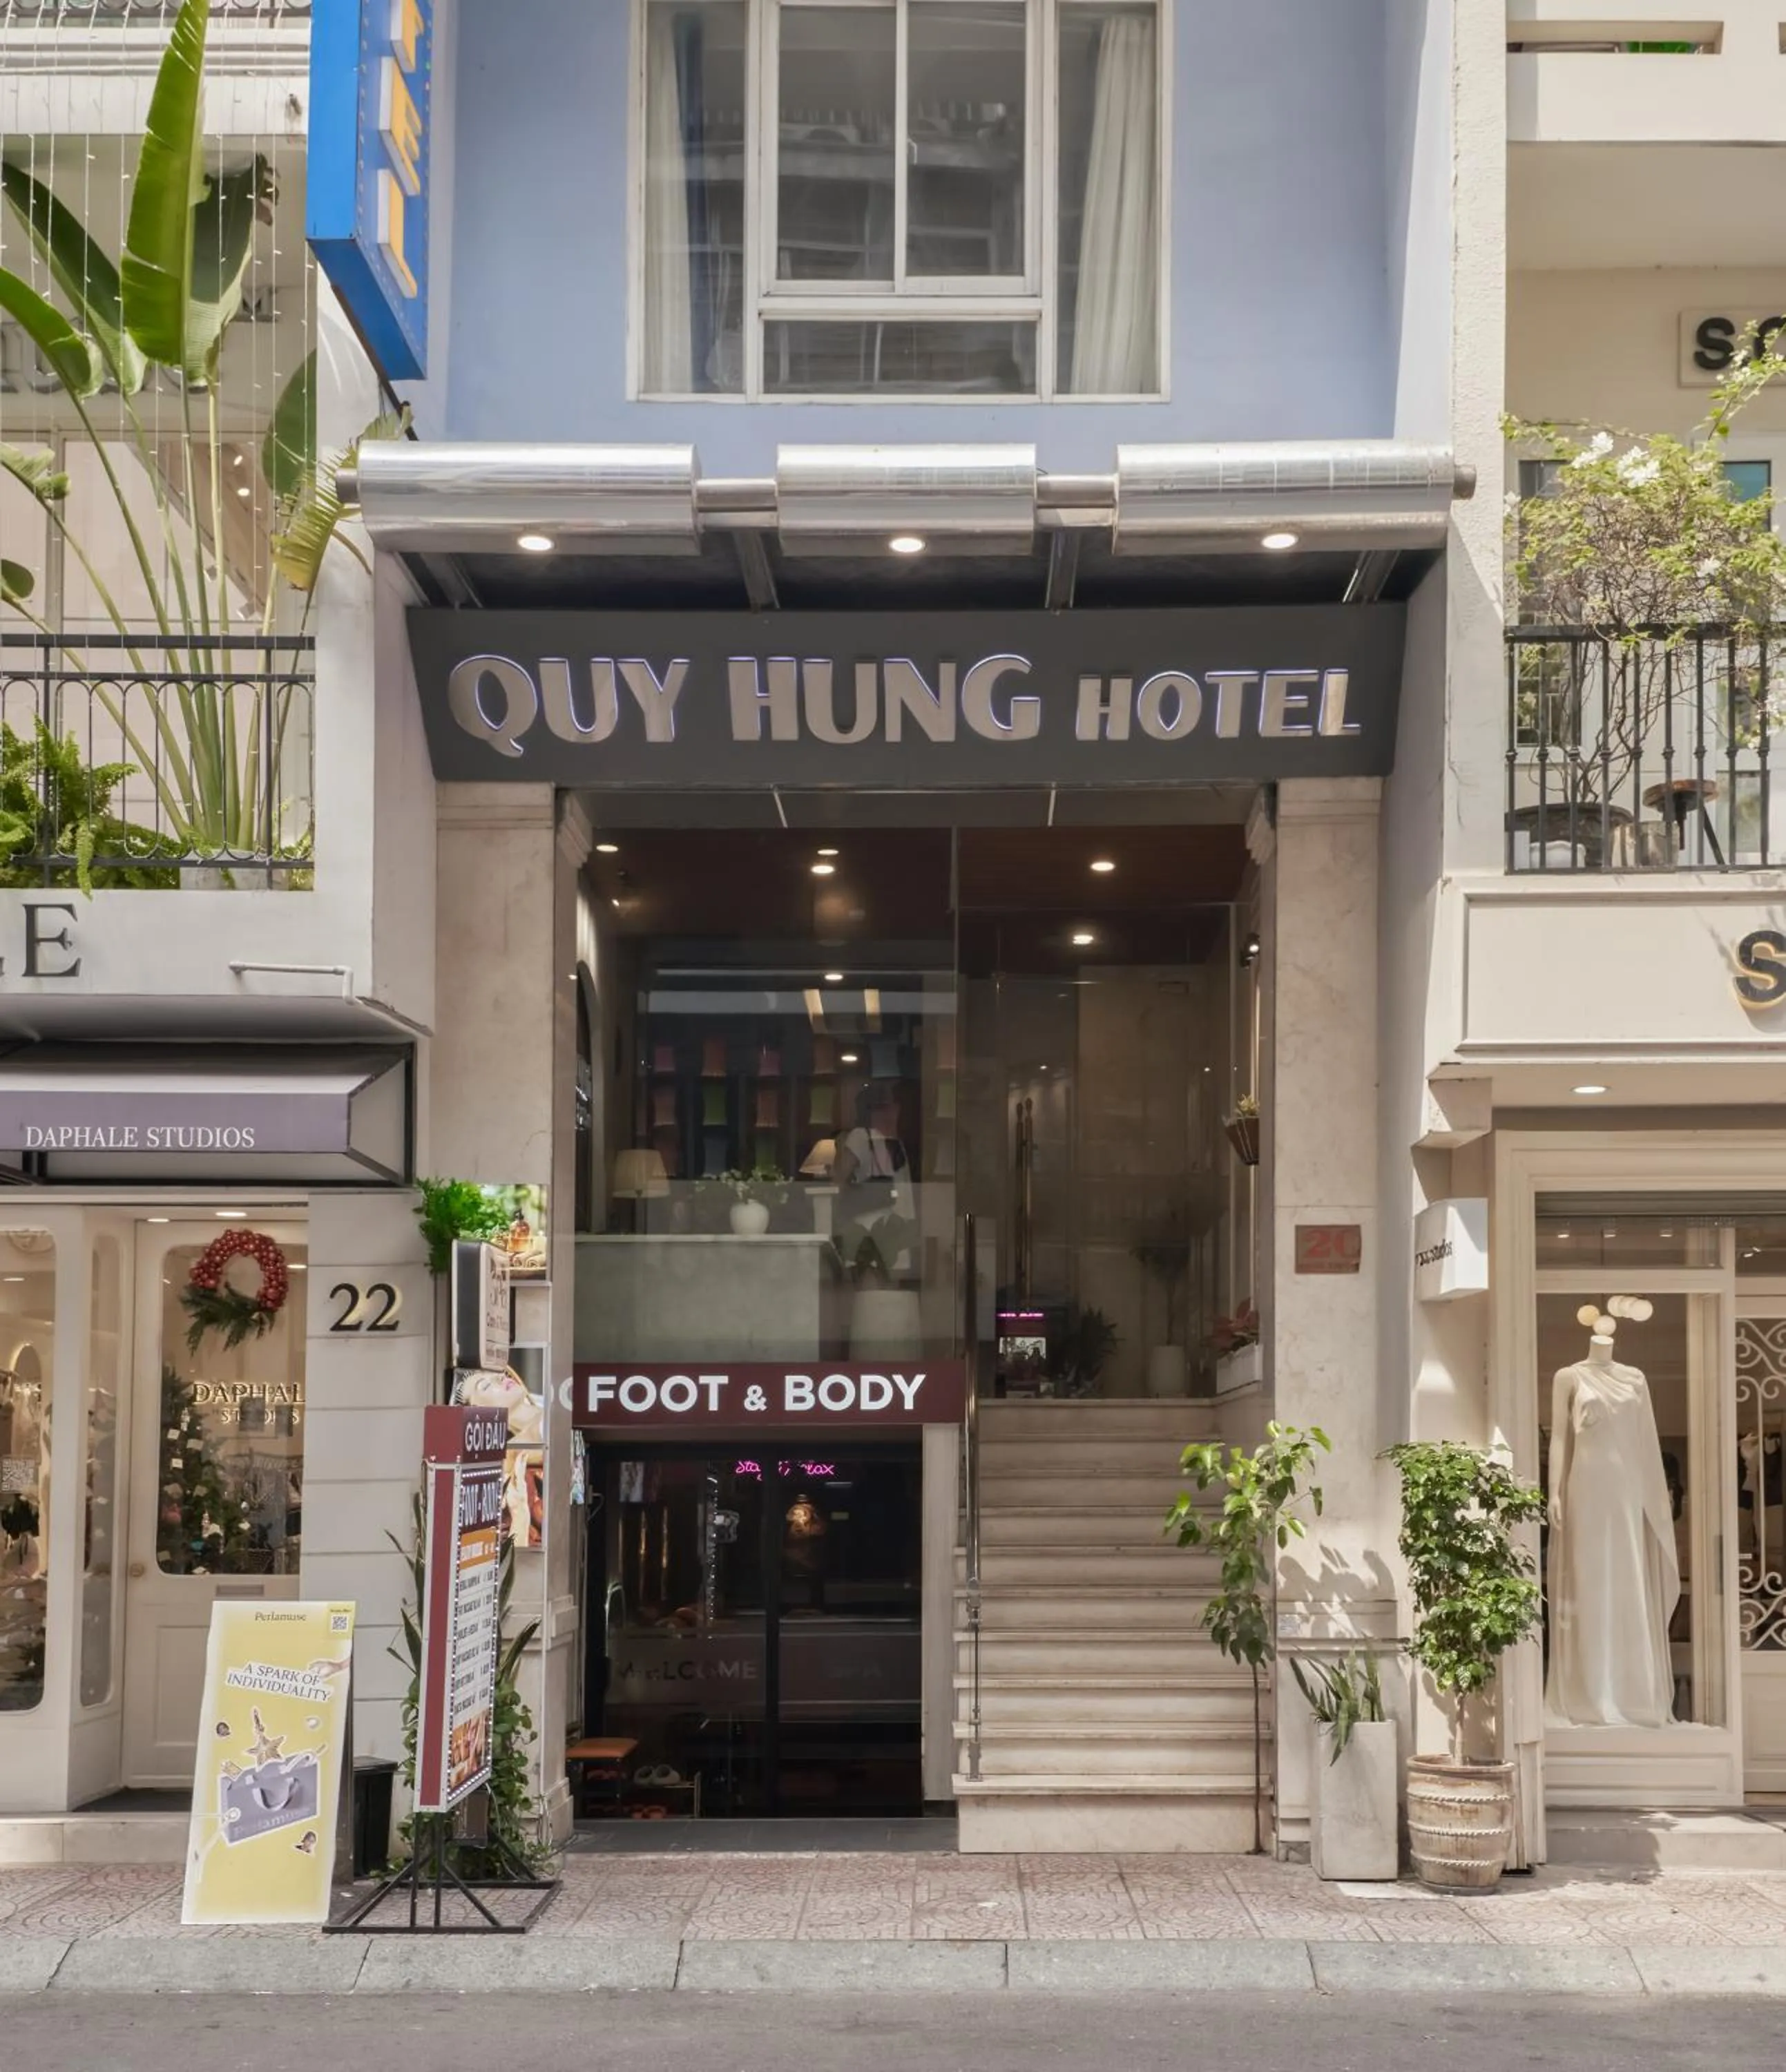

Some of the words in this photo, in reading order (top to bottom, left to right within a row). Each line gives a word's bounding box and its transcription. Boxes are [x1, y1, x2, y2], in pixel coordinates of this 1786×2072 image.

[448, 654, 689, 758] QUY
[728, 654, 1041, 745] HUNG
[1075, 667, 1361, 742] HOTEL
[0, 903, 81, 977] E
[25, 1125, 138, 1149] DAPHALE
[146, 1125, 256, 1149] STUDIOS
[329, 1283, 401, 1332] 22
[587, 1374, 729, 1412] FOOT
[743, 1385, 767, 1411] &
[785, 1374, 926, 1412] BODY
[221, 1408, 300, 1425] STDIS
[736, 1460, 763, 1481] Sta
[255, 1611, 307, 1622] Perlamuse
[244, 1663, 253, 1673] A
[256, 1665, 300, 1683] SPARK
[227, 1673, 331, 1701] INDIVIDUALITY
